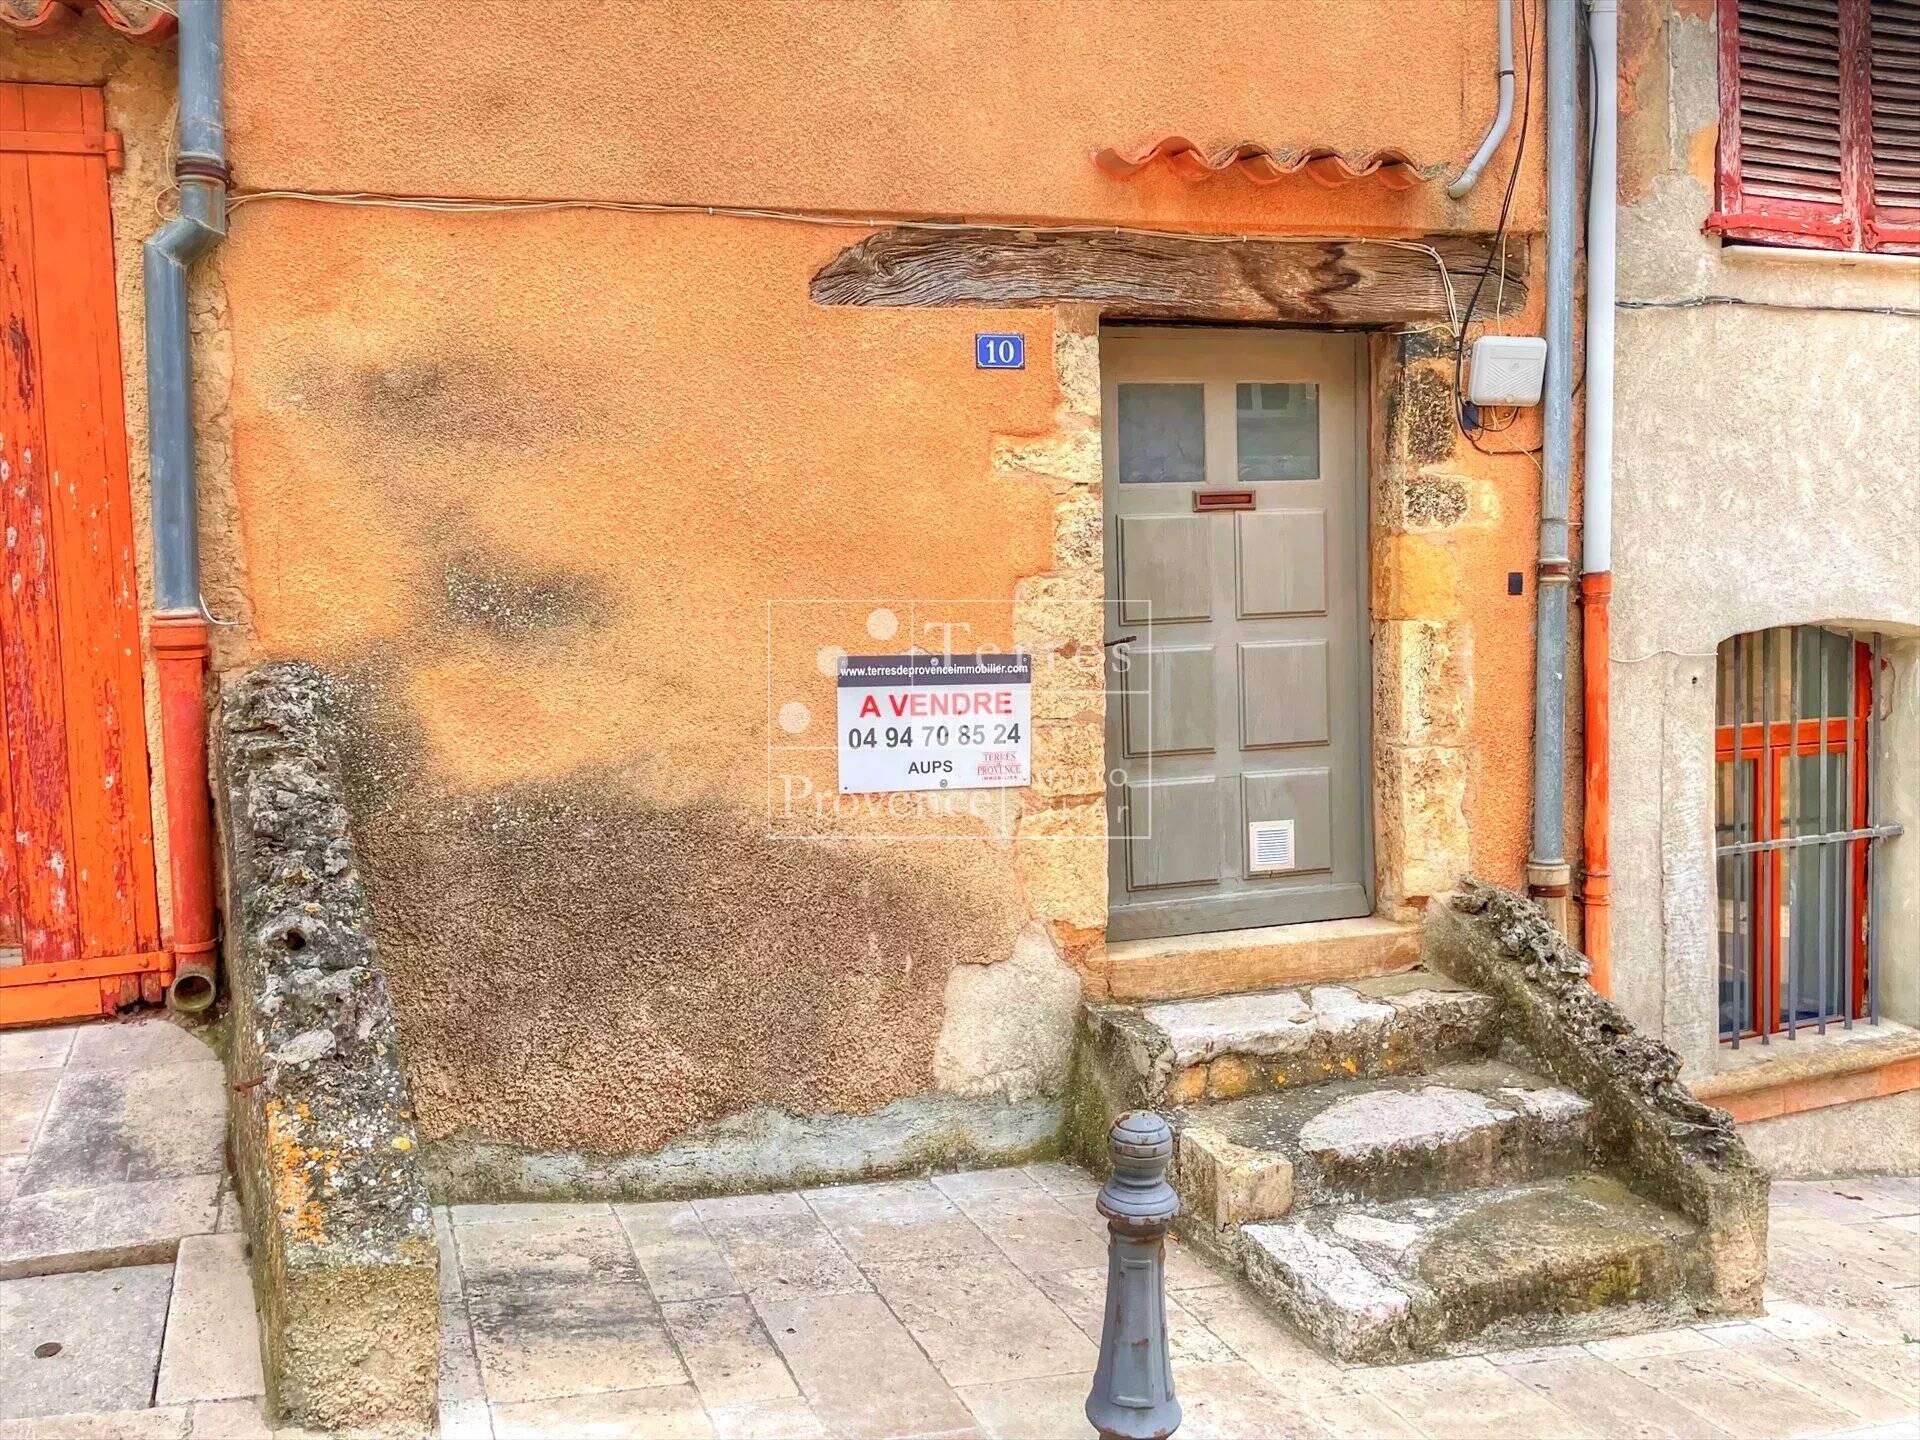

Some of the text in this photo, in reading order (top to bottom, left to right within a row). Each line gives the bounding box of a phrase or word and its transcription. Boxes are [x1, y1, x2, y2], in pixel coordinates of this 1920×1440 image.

[986, 340, 1015, 363] 10
[840, 663, 1028, 678] www.terresdeprovenceimmobilier.com
[859, 692, 1012, 718] A VENDRE
[849, 723, 1021, 750] 04 94 70 85 24
[908, 760, 953, 775] AUPS
